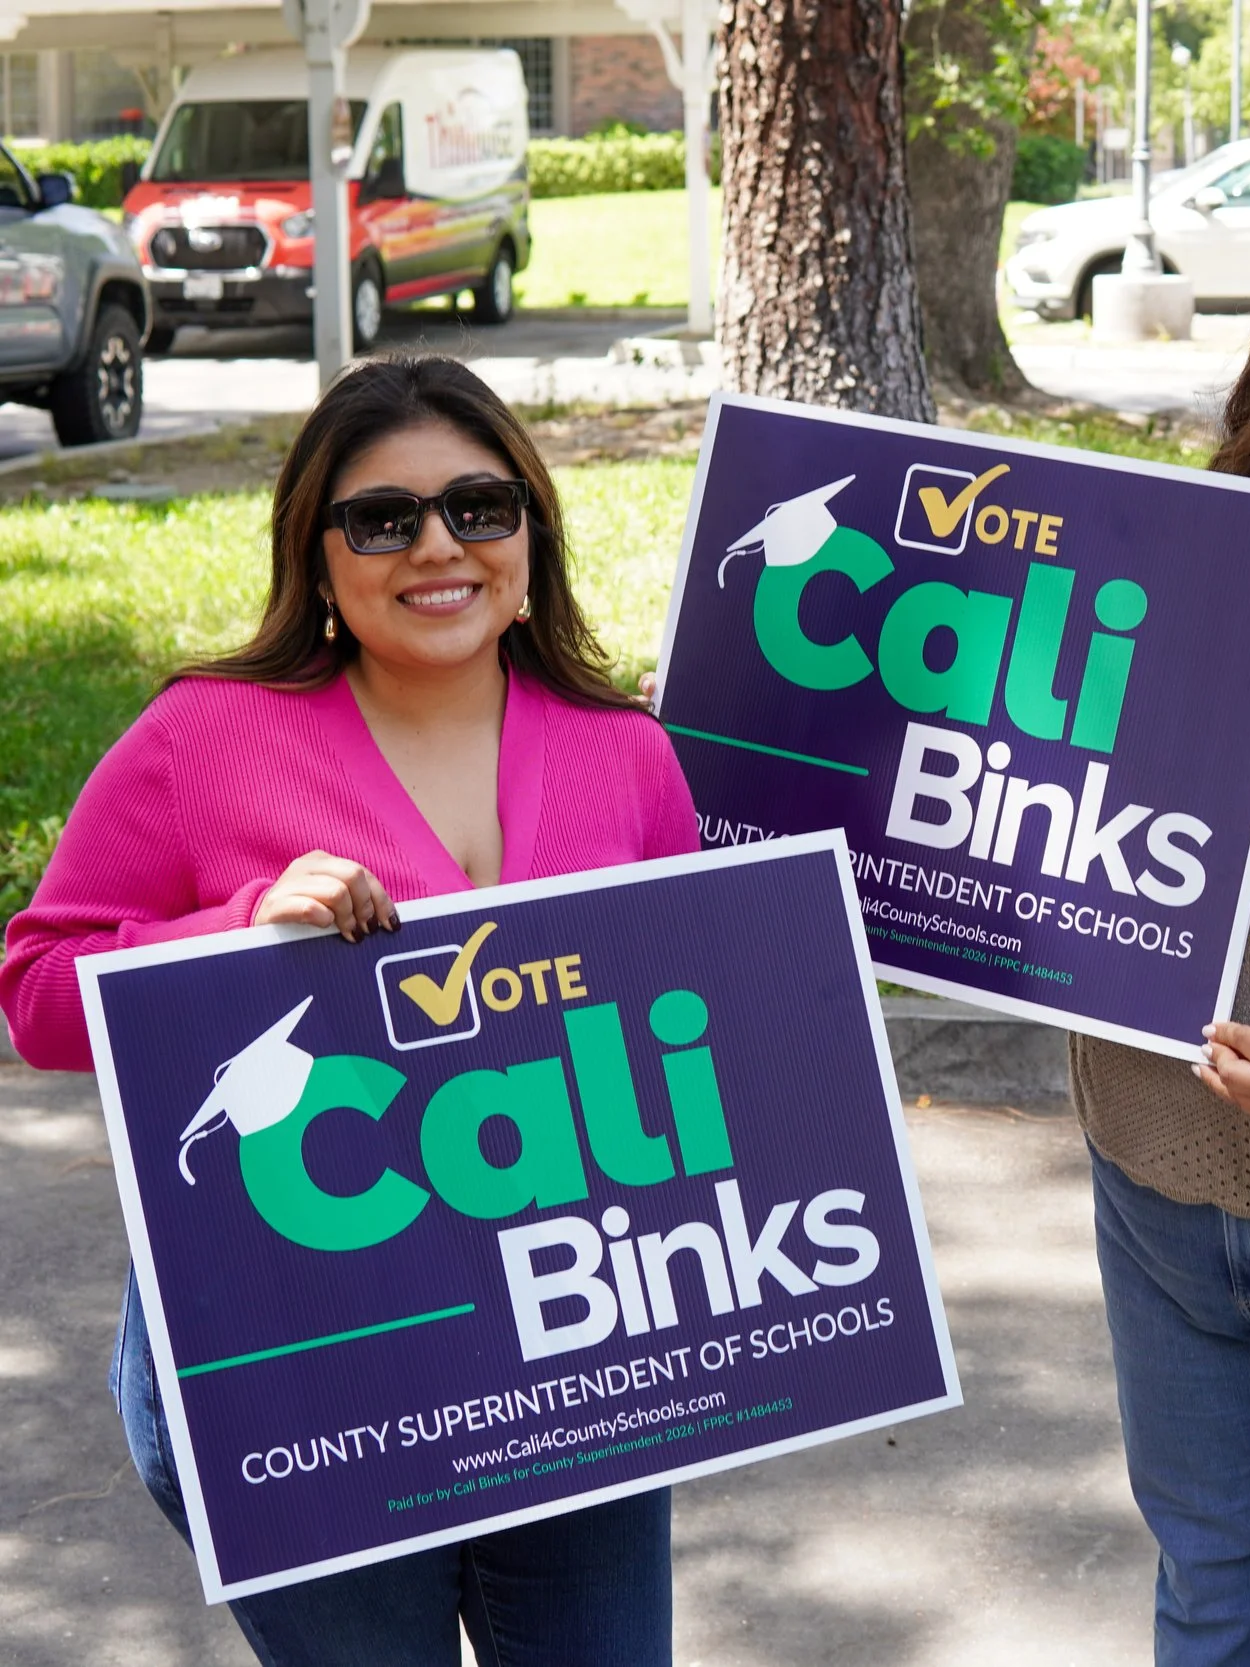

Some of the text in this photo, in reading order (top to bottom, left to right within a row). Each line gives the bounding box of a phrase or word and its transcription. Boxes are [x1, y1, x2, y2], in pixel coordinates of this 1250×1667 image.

[753, 524, 1150, 756] Cali
[885, 721, 1214, 908] Binks
[860, 896, 1022, 953] li4CountySchools.com
[889, 929, 960, 957] Superintendent
[962, 948, 987, 963] 2026
[994, 955, 1021, 972] FPPC
[1022, 963, 1074, 985] #1484453
[1014, 892, 1057, 925] OF
[1057, 902, 1195, 959] SCHOOLS
[238, 988, 736, 1253] Cali
[497, 1178, 882, 1363] Binks
[241, 1297, 895, 1484] COUNTY SUPERINTENDENT OF SCHOOLS
[387, 1493, 414, 1512] Paid
[417, 1489, 434, 1505] for
[436, 1484, 451, 1501] by
[453, 1480, 476, 1496] Cali
[479, 1473, 511, 1490] Binks
[513, 1466, 530, 1481] for
[532, 1456, 574, 1476] County
[576, 1432, 664, 1465] Superintendent
[666, 1424, 695, 1442] 2026
[702, 1412, 734, 1432] FPPC
[736, 1397, 794, 1423] #1484453
[452, 1391, 727, 1474] www.Cali4CountySchools.com
